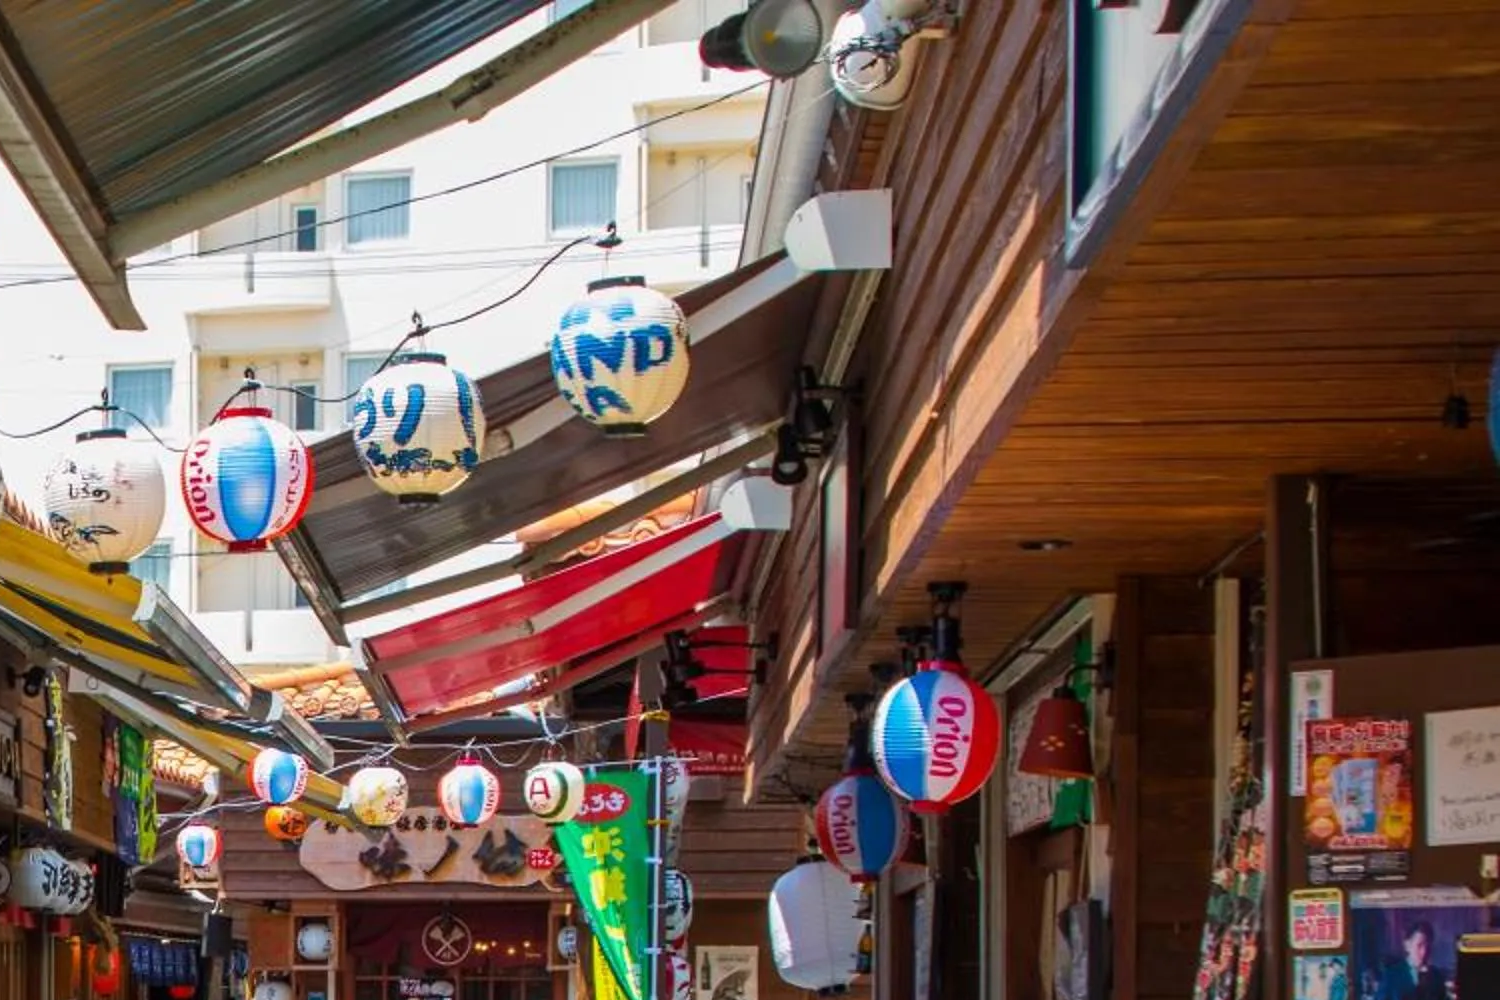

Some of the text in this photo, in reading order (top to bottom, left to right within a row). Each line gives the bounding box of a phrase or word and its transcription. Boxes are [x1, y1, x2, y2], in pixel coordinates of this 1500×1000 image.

[189, 440, 217, 523] Orion
[929, 696, 970, 778] Orion
[831, 793, 857, 856] Orion
